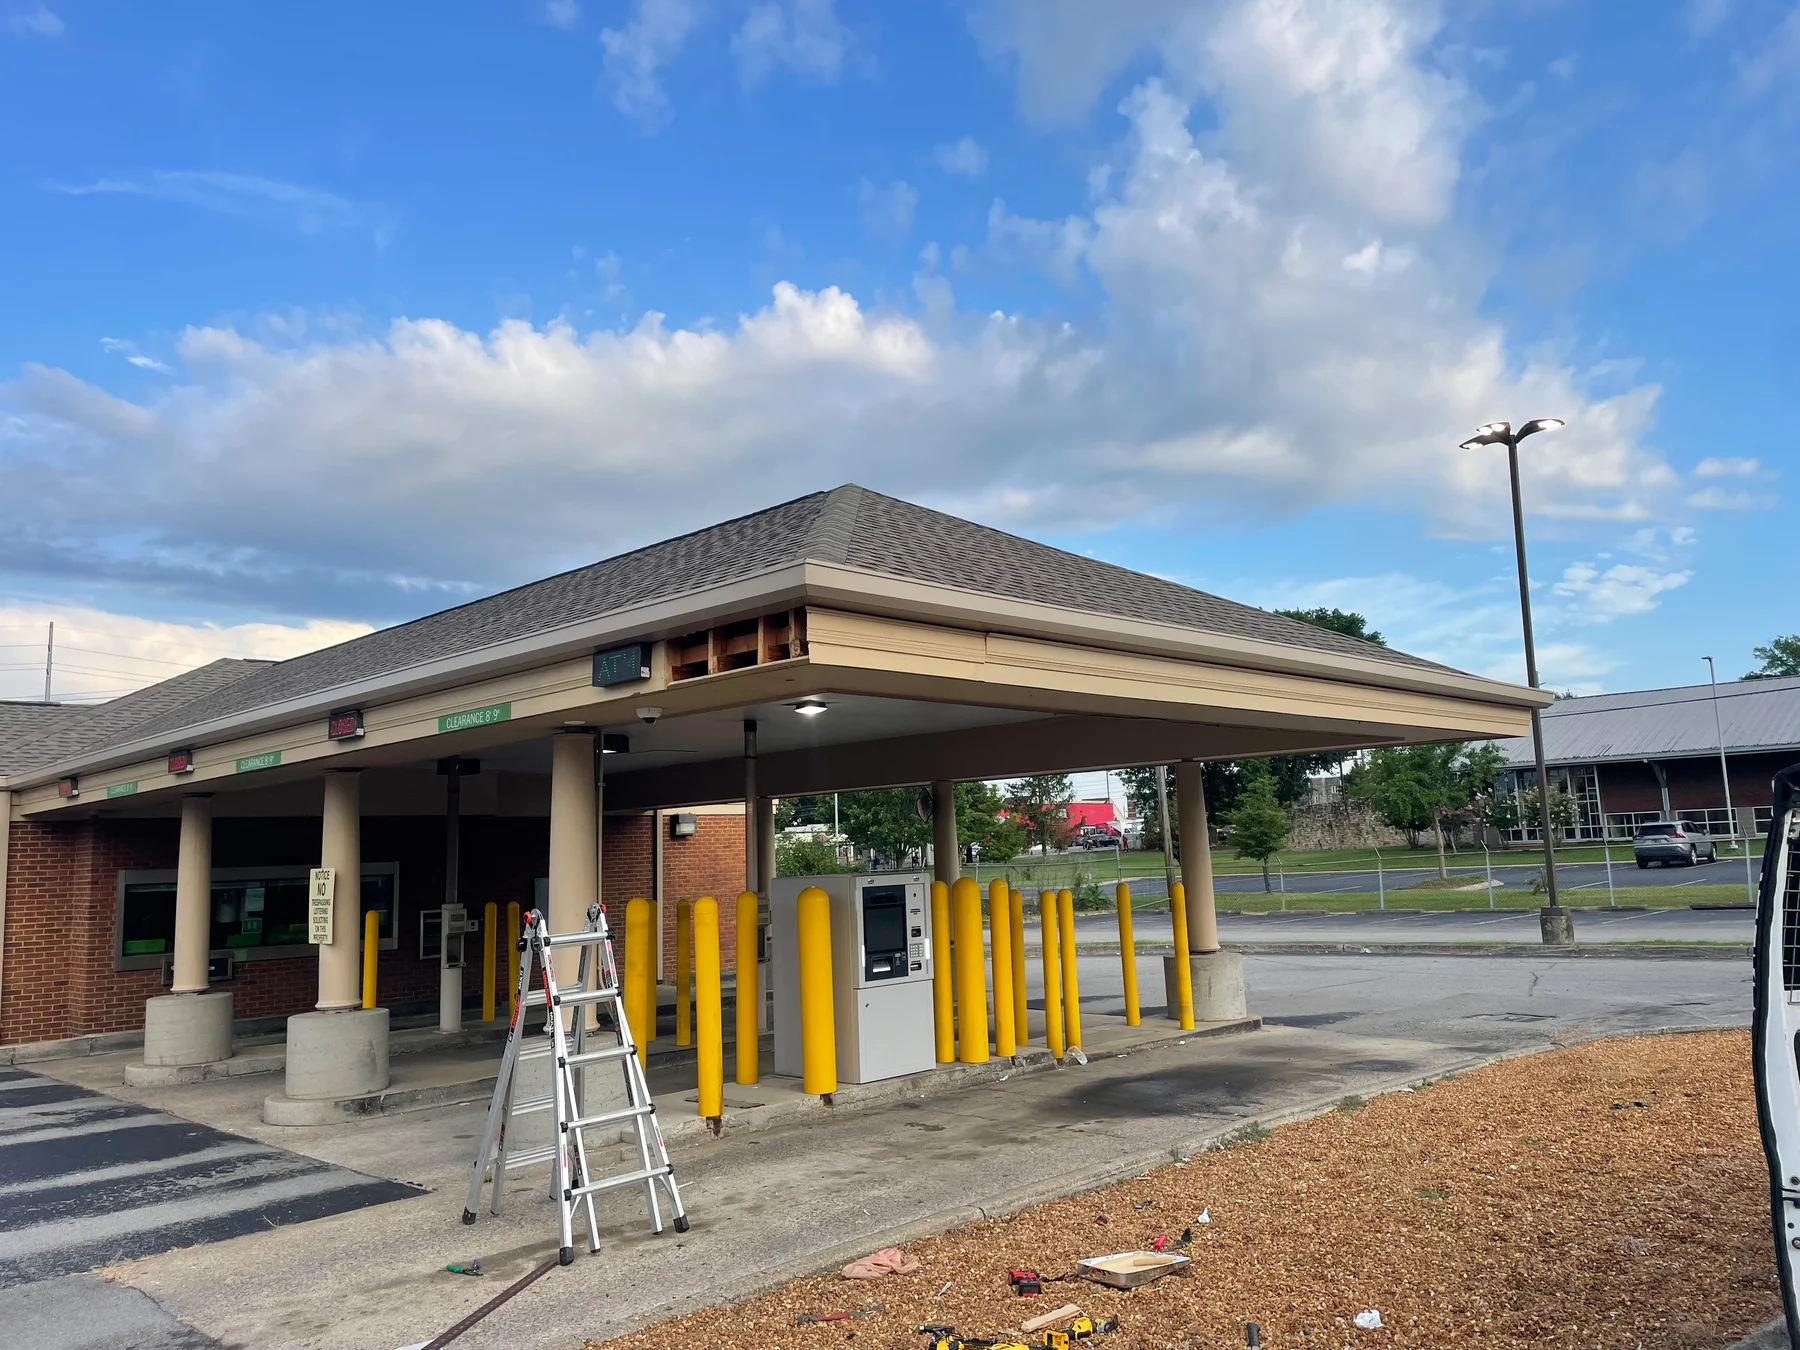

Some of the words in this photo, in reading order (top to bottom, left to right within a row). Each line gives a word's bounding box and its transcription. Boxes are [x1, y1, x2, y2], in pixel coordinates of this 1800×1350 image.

[598, 651, 635, 682] ATM
[331, 717, 355, 736] CLOSED
[446, 711, 484, 729] CLEARANCE
[240, 756, 264, 770] CLEARANCE
[315, 870, 330, 880] NOTICE
[317, 882, 326, 896] NO
[315, 925, 320, 933] ON
